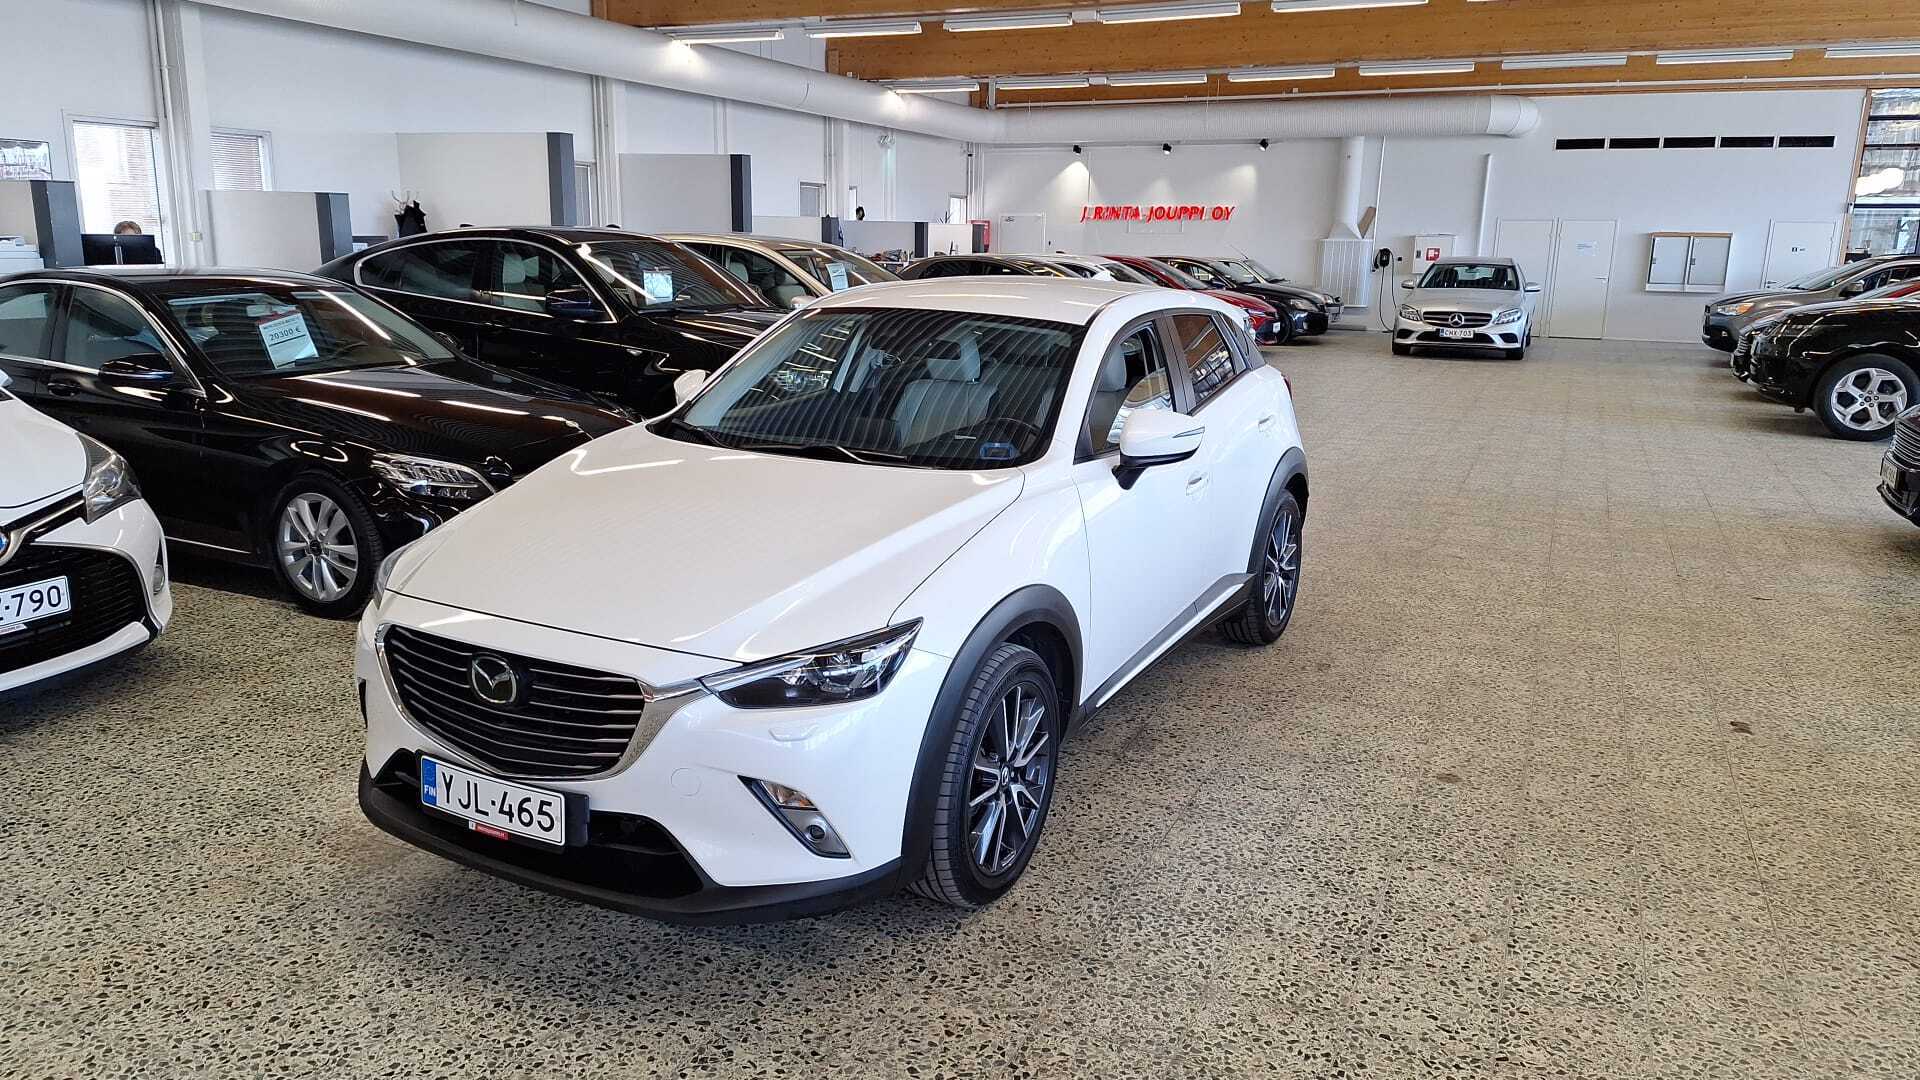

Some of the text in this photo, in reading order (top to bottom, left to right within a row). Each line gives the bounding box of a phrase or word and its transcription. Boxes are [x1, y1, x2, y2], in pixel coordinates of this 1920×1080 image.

[1211, 206, 1235, 221] OY
[424, 784, 436, 797] FIN
[442, 772, 555, 832] YJL-465
